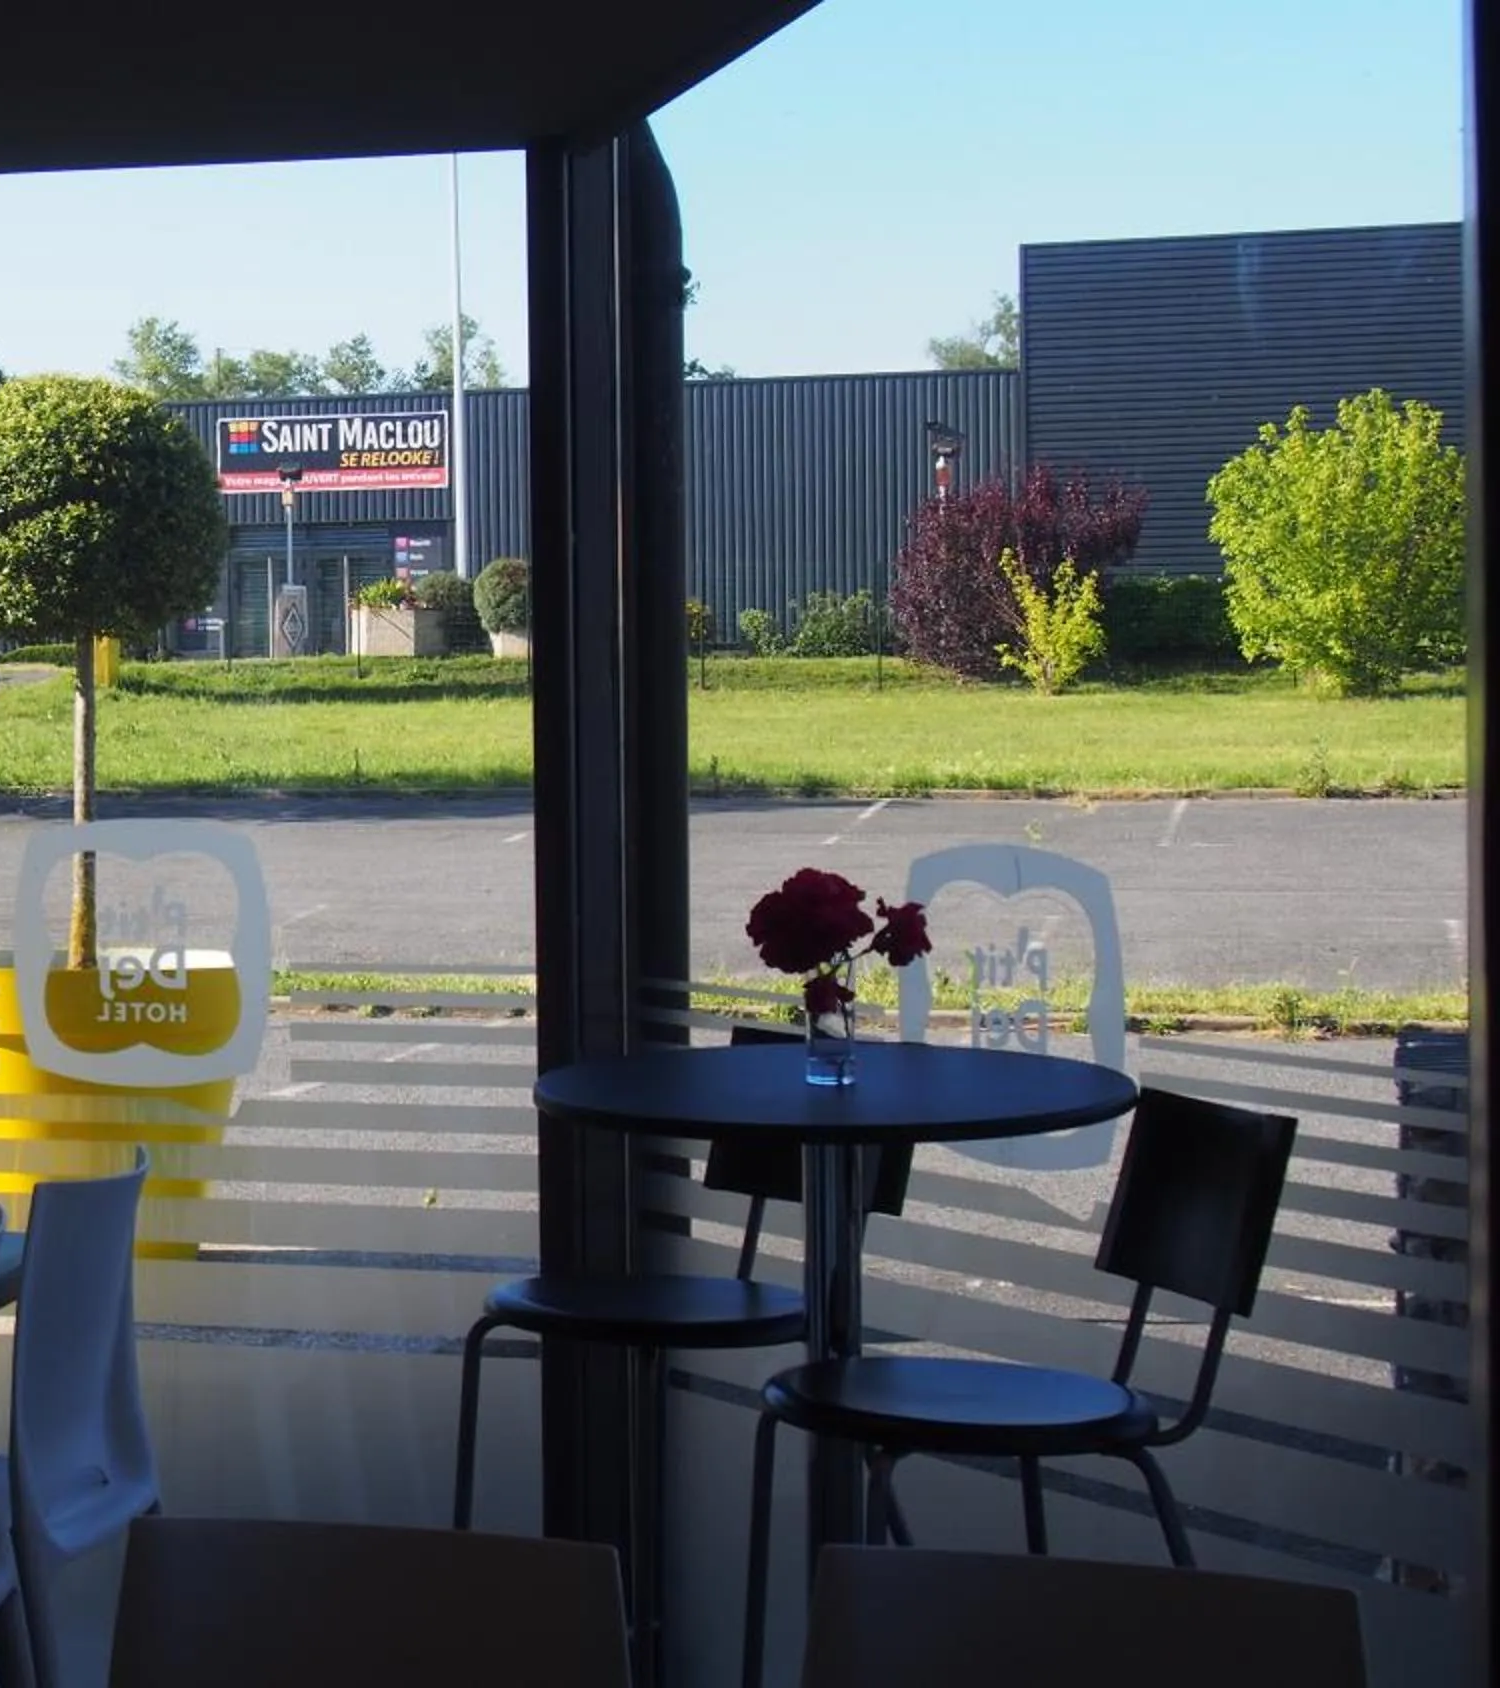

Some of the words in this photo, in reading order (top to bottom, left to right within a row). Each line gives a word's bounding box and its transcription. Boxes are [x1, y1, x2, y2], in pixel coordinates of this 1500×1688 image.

[261, 421, 332, 453] SAINT
[338, 417, 440, 450] MACLOU
[340, 453, 360, 468] SE
